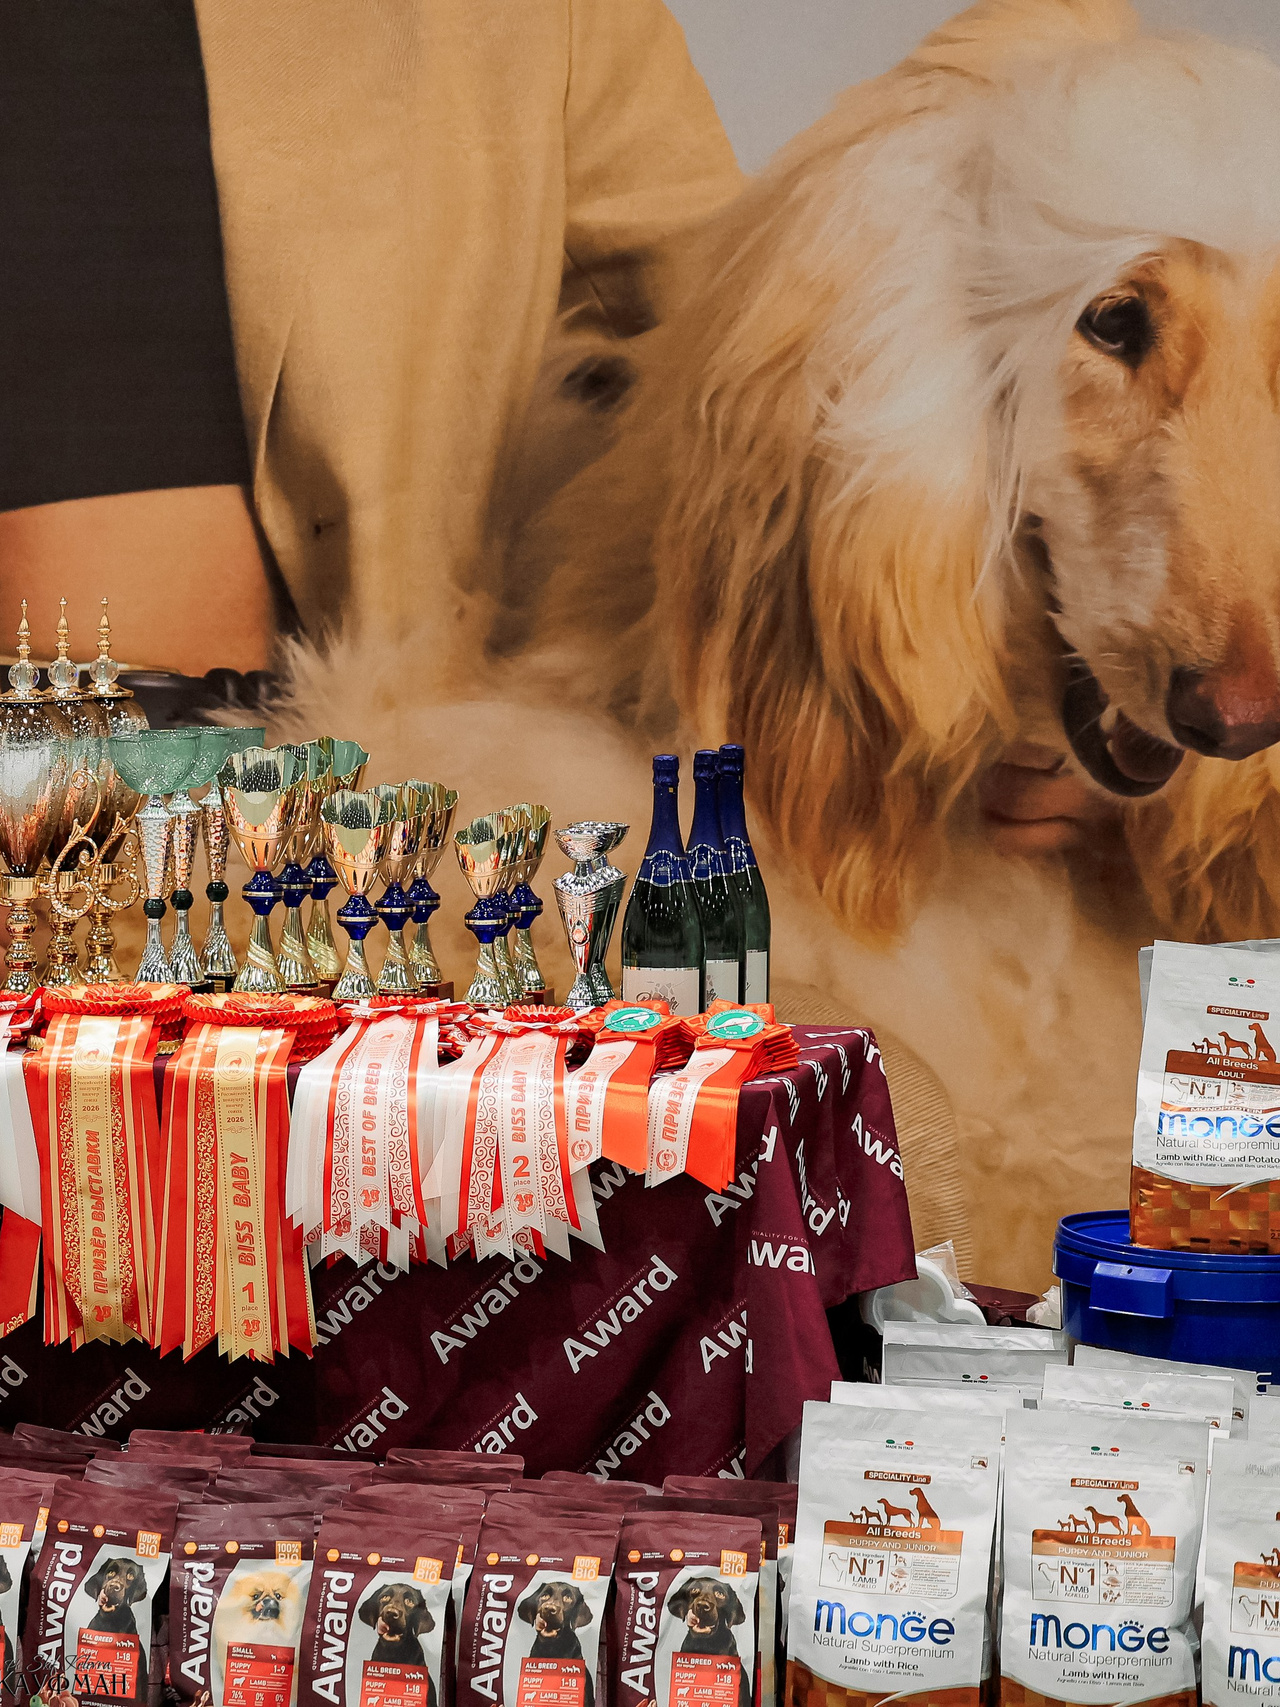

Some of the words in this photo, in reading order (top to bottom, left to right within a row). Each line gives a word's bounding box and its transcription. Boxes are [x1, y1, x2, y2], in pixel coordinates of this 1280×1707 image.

[1211, 1006, 1250, 1018] SPECIALITY
[1206, 1057, 1220, 1065] All
[1223, 1059, 1258, 1070] Breeds
[1218, 1070, 1245, 1079] ADULT
[363, 1063, 382, 1105] BREED
[511, 1070, 527, 1102] BABY
[363, 1110, 376, 1131] OF
[511, 1108, 526, 1143] BISS
[1156, 1137, 1199, 1148] Natural
[1203, 1139, 1280, 1152] Superpremiu
[362, 1136, 377, 1177] BEST
[1156, 1153, 1180, 1161] Lamb
[1249, 1155, 1280, 1164] Potato
[512, 1156, 530, 1177] 2
[85, 1130, 106, 1223] ВЫСТАВКИ
[230, 1152, 251, 1207] BABY
[234, 1220, 256, 1266] BISS
[242, 1282, 255, 1303] 1
[869, 1472, 911, 1481] SPECIALITY
[867, 1528, 882, 1536] All
[884, 1529, 921, 1539] Breeds
[1075, 1535, 1089, 1544] All
[1092, 1536, 1131, 1546] Breeds
[850, 1539, 879, 1547] PUPPY
[904, 1543, 936, 1551] JUNIOR
[1058, 1547, 1087, 1556] PUPPY
[1092, 1549, 1111, 1557] AND
[1115, 1551, 1148, 1559] JUNIOR
[38, 1541, 83, 1669] Award
[813, 1633, 857, 1650] Natural
[862, 1640, 954, 1659] Superpremium
[845, 1656, 870, 1666] Lamb
[873, 1659, 894, 1668] with
[898, 1661, 918, 1670] Rice
[1028, 1647, 1074, 1663] Natural
[1079, 1652, 1172, 1667] Superpremium
[1063, 1668, 1089, 1678] Lamb
[1092, 1671, 1114, 1680] with
[1118, 1670, 1139, 1680] Rice
[1227, 1679, 1273, 1696] Natural
